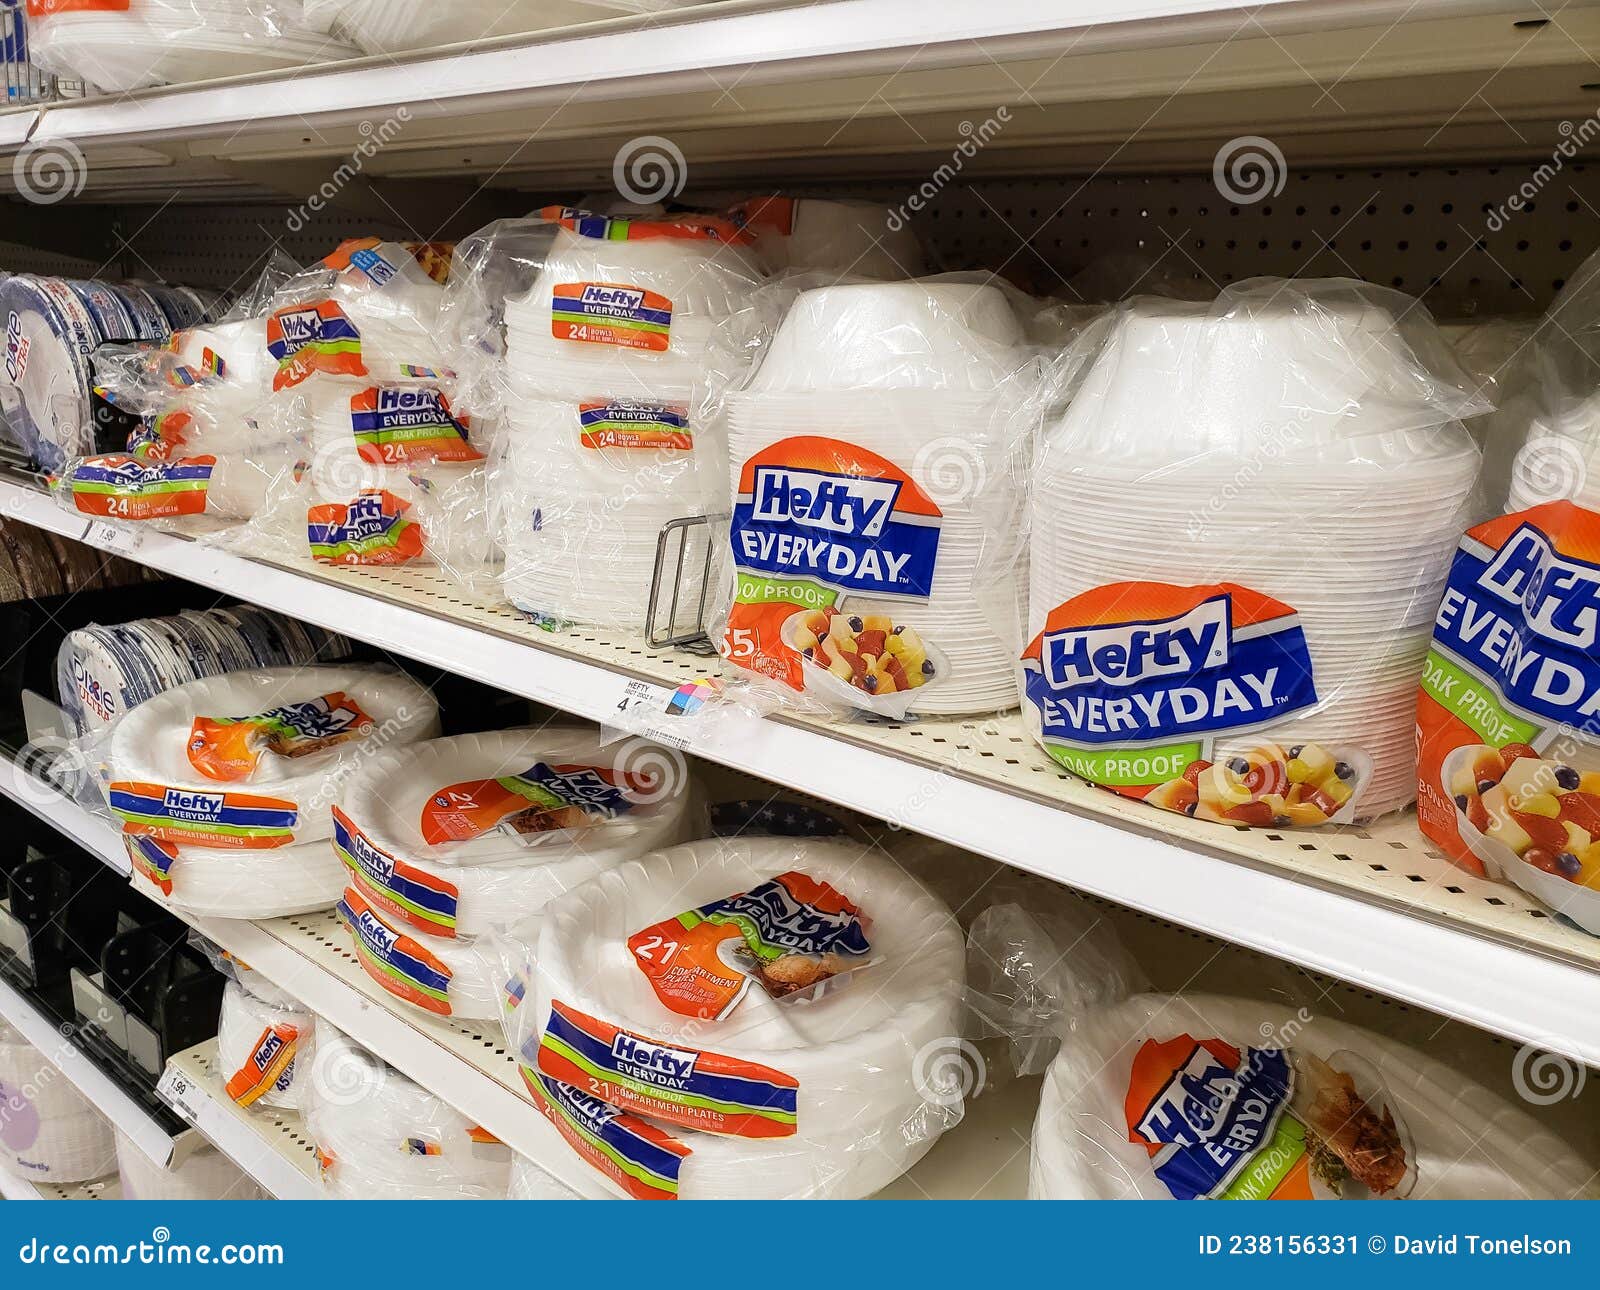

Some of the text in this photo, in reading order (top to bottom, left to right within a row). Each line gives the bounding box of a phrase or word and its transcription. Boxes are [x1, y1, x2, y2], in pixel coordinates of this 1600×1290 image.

[585, 287, 639, 309] Hefty
[584, 304, 635, 319] EVERYDAY
[568, 323, 588, 340] 24
[608, 411, 659, 421] EVERYDAY
[598, 431, 616, 447] 24
[383, 444, 408, 462] 24
[106, 497, 130, 515] 24
[758, 473, 888, 536] Hefty
[740, 529, 912, 585] EVERYDAY
[765, 585, 825, 608] PROOF
[1049, 620, 1221, 684] Hefty
[1435, 586, 1600, 718] EVERYDA
[626, 680, 651, 693] HEFTY
[78, 684, 112, 722] ULTRA
[1043, 666, 1279, 734] EVERYDAY
[1422, 659, 1514, 744] OAK PROOF
[1105, 753, 1185, 778] PROOF
[166, 790, 221, 812] Hefty
[447, 791, 479, 811] 21
[1418, 778, 1455, 818] BOWLS
[168, 808, 217, 822] EVERYDAY
[147, 826, 244, 846] 21 COMPARTMENT PLATES
[356, 838, 393, 875] Hefty
[359, 913, 393, 952] Hefty
[635, 936, 679, 965] 21
[616, 1036, 692, 1078] Hefty
[170, 1076, 187, 1096] 1.99
[274, 1075, 290, 1093] 45
[616, 1062, 686, 1089] EVERYDAY
[588, 1077, 610, 1099] 21
[613, 1087, 686, 1114] COMPARTMENT
[687, 1107, 725, 1122] PLATES
[648, 1086, 686, 1103] PROOF
[558, 1093, 602, 1135] EVERYDAY
